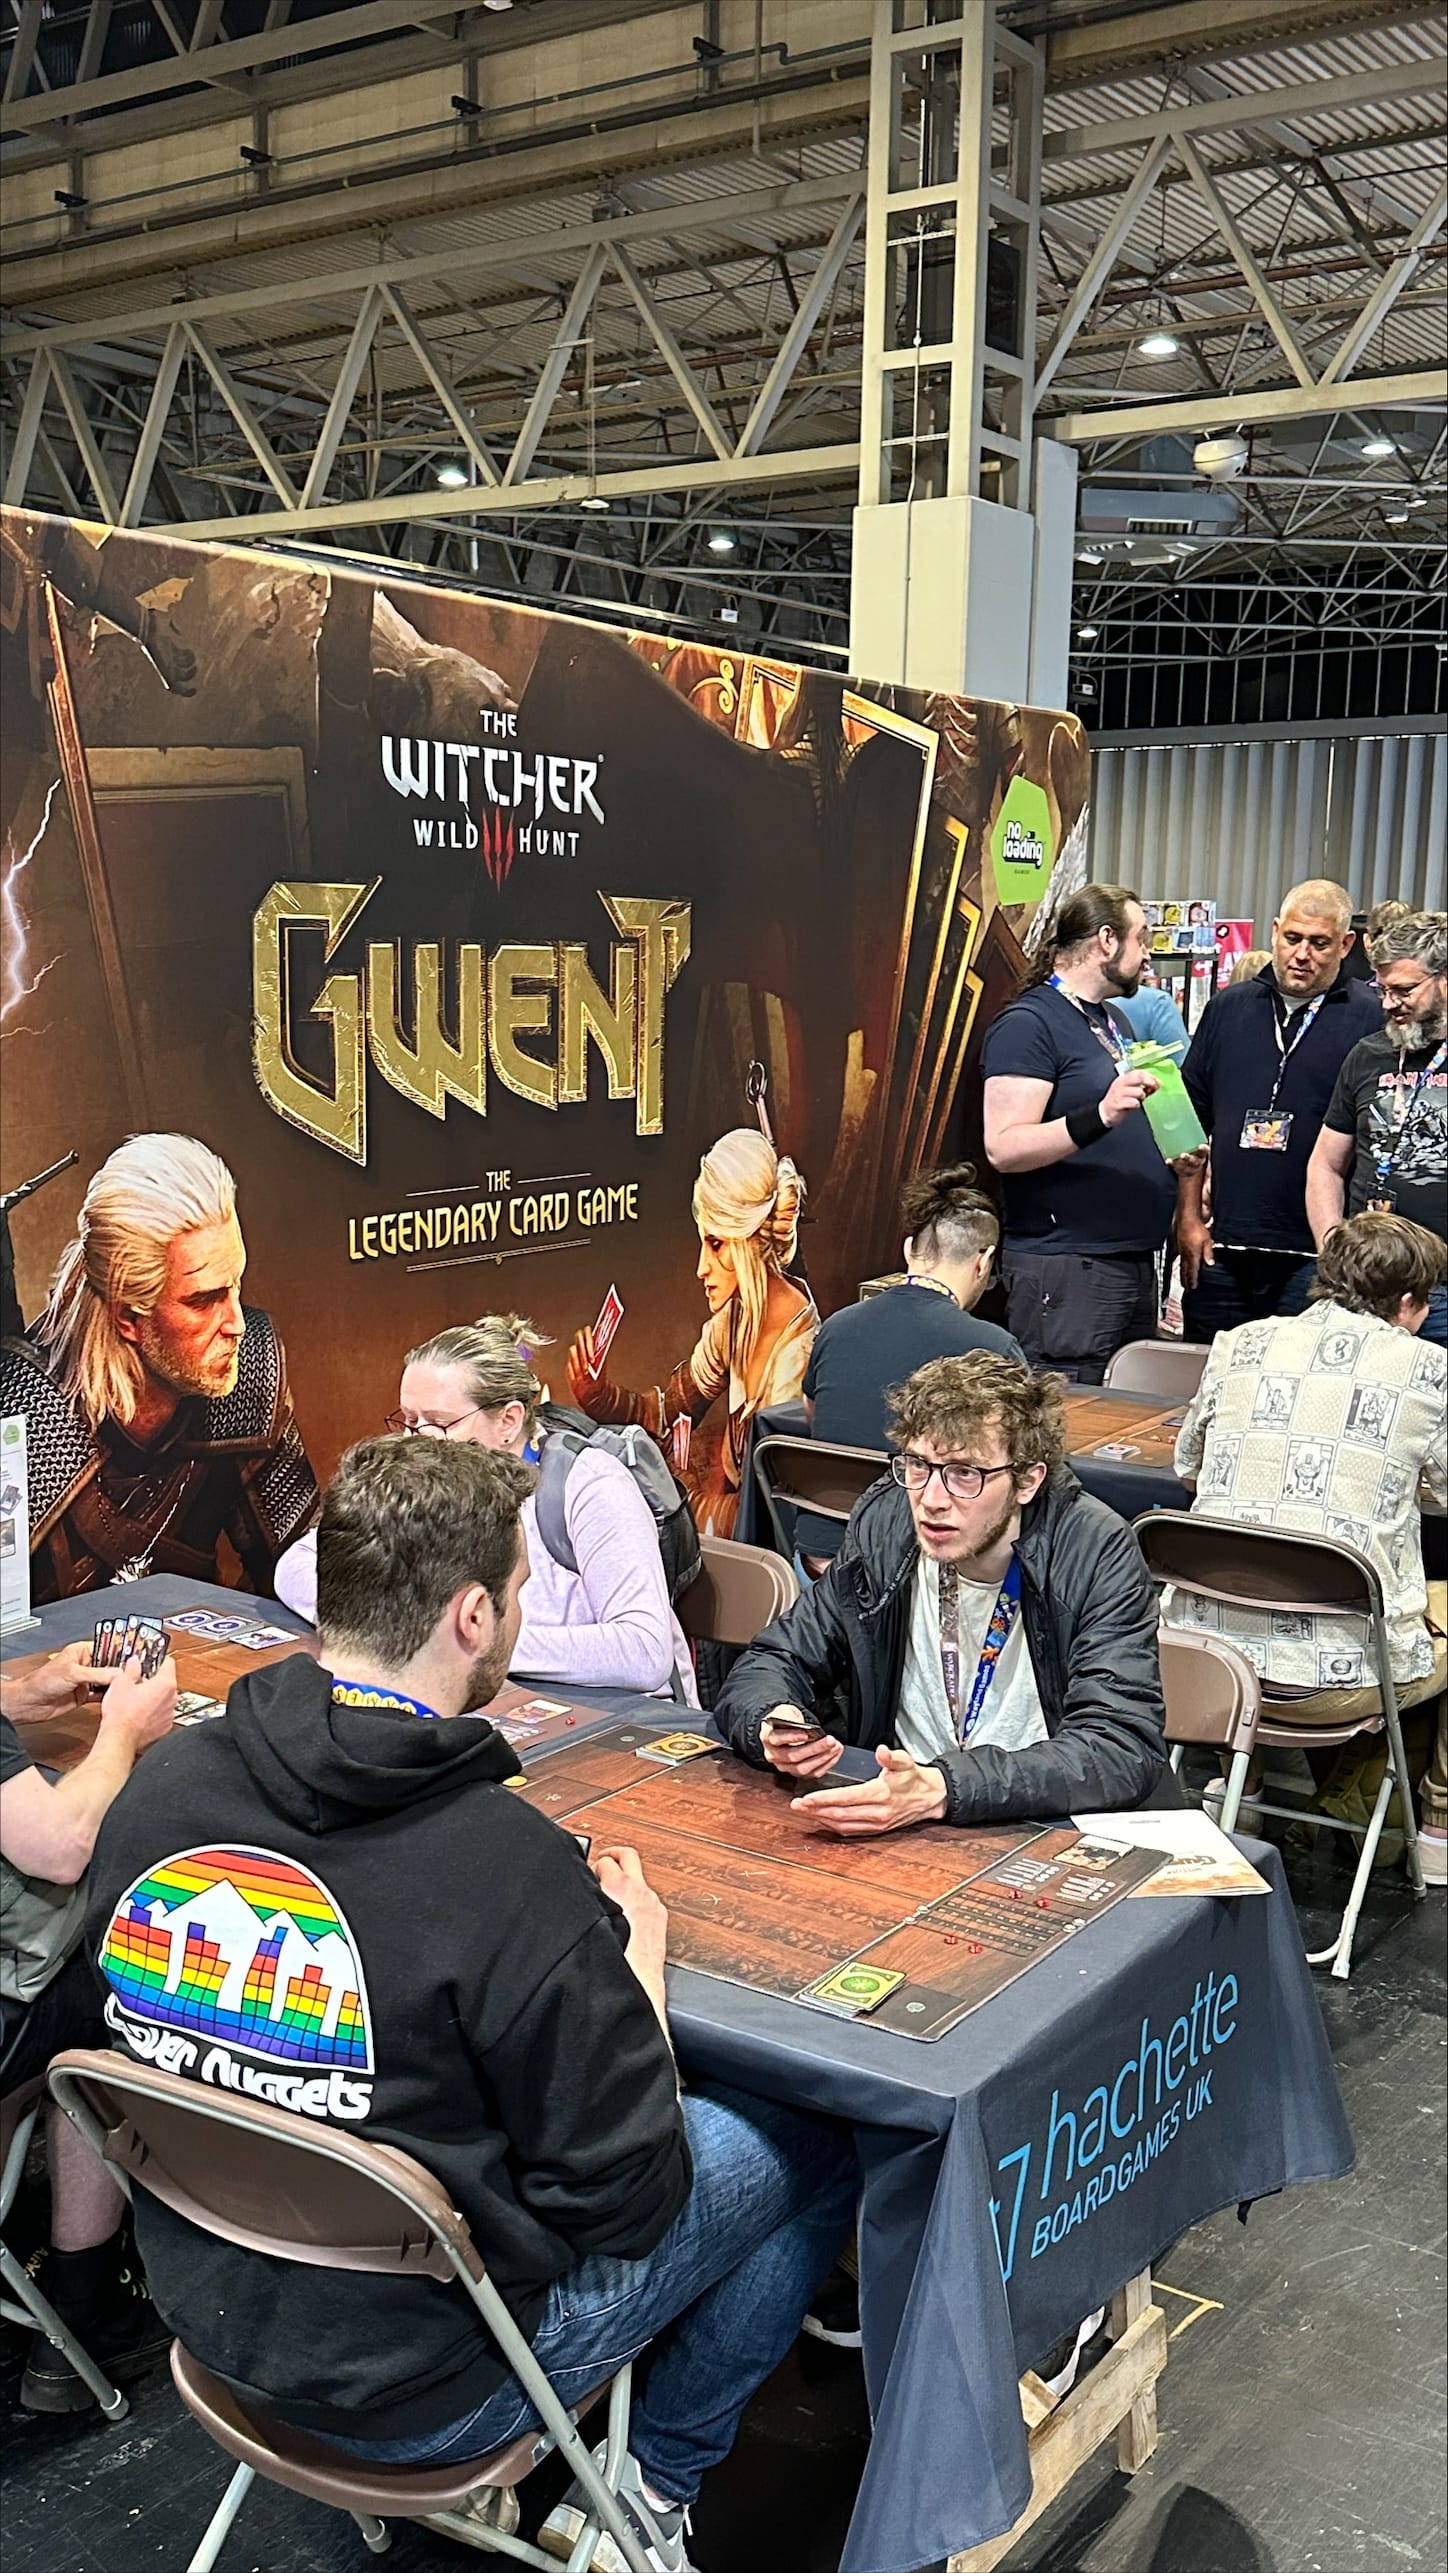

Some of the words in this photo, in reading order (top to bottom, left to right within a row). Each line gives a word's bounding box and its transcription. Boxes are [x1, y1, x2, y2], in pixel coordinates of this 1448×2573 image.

[480, 709, 518, 738] THE
[381, 735, 605, 825] WITCHER
[412, 814, 479, 850] WILD
[519, 820, 580, 857] HUNT
[1003, 832, 1044, 867] loading
[1006, 821, 1022, 840] no
[252, 875, 693, 1167] GWENT
[486, 1169, 511, 1192] THE
[349, 1200, 501, 1260] LEGENDARY
[509, 1192, 570, 1237] CARD
[577, 1183, 639, 1226] GAME
[1041, 1970, 1239, 2200] hachette
[1030, 2100, 1182, 2259] BOARDGAMES
[1185, 2068, 1213, 2121] UK
